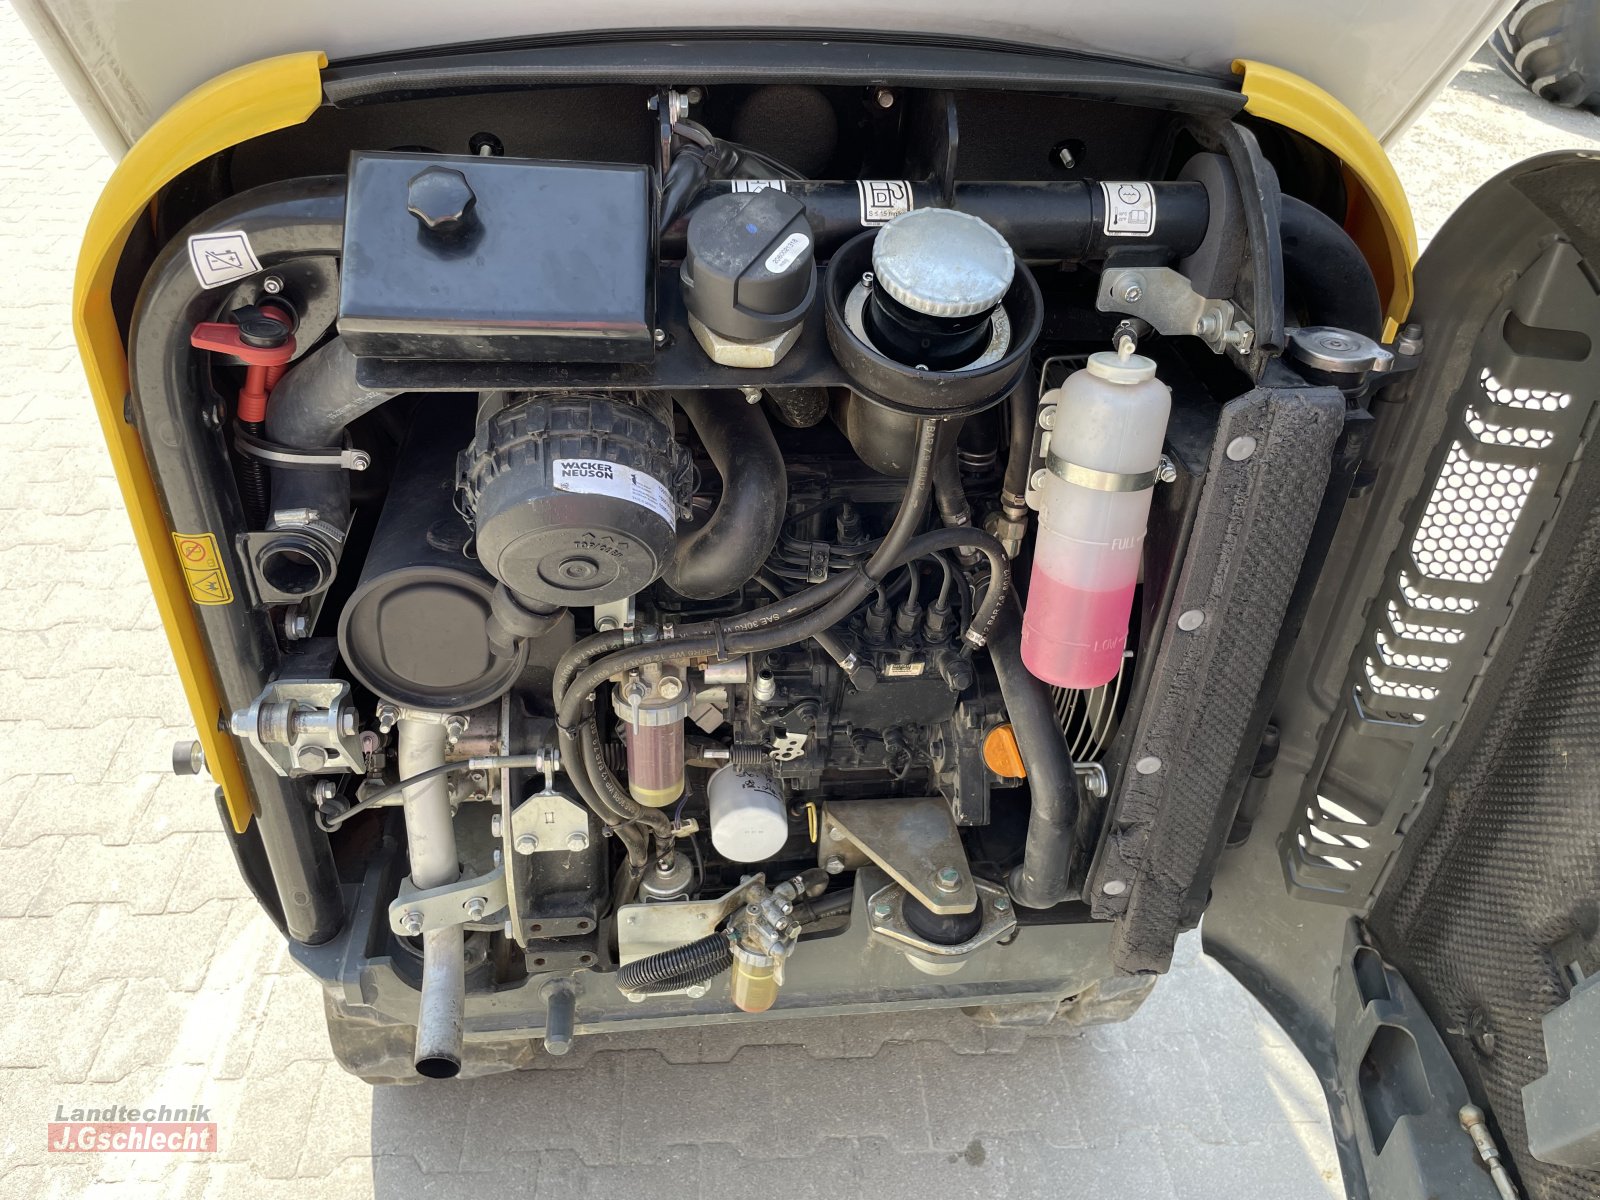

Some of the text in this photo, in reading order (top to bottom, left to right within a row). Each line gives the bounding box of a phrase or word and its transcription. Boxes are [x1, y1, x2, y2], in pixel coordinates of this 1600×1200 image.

[876, 192, 887, 203] D
[926, 425, 936, 445] BAR
[561, 462, 613, 472] WACKER
[562, 469, 614, 480] NEUSON
[1111, 537, 1135, 551] FULL
[759, 612, 781, 626] SAE
[986, 607, 1000, 626] BAR
[1094, 638, 1118, 652] LOW
[595, 754, 605, 771] BAR
